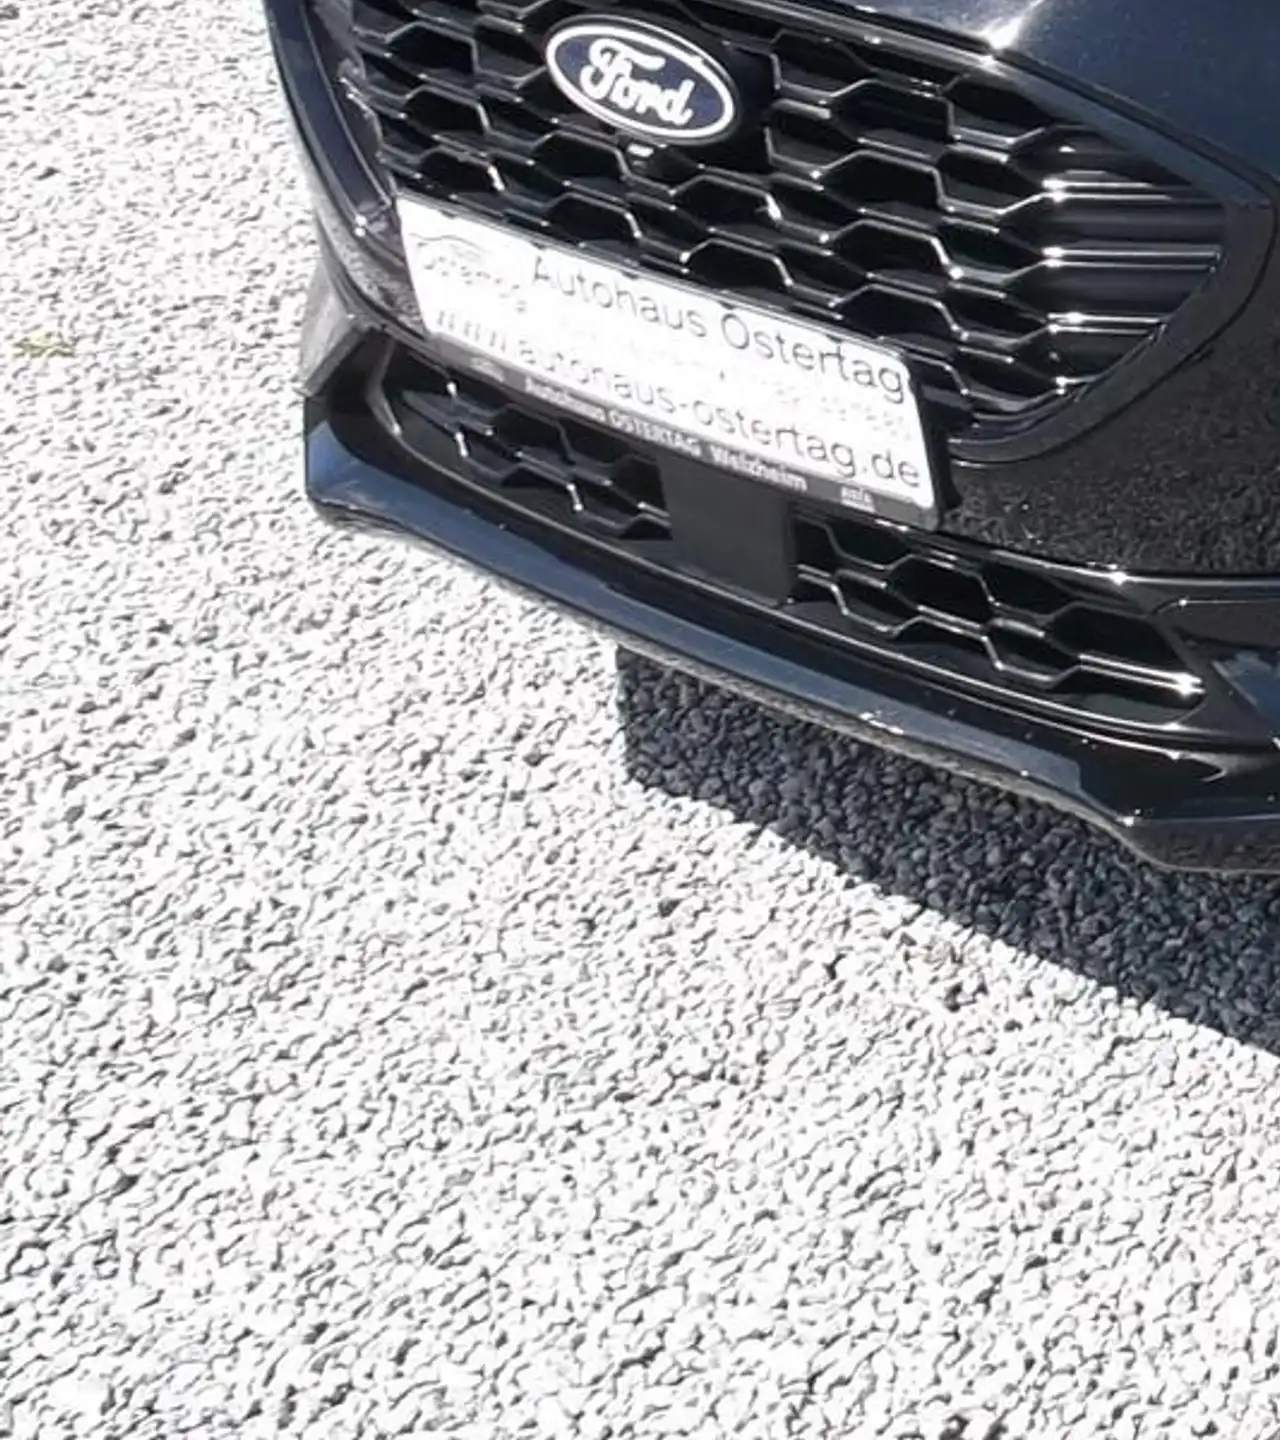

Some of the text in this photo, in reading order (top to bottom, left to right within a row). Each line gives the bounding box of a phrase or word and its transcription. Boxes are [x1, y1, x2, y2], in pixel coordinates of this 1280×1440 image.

[579, 37, 695, 126] Ford
[435, 309, 920, 488] wwwautohaus-ostertag.de
[532, 255, 707, 338] Autohaus
[721, 313, 905, 404] Ostertag
